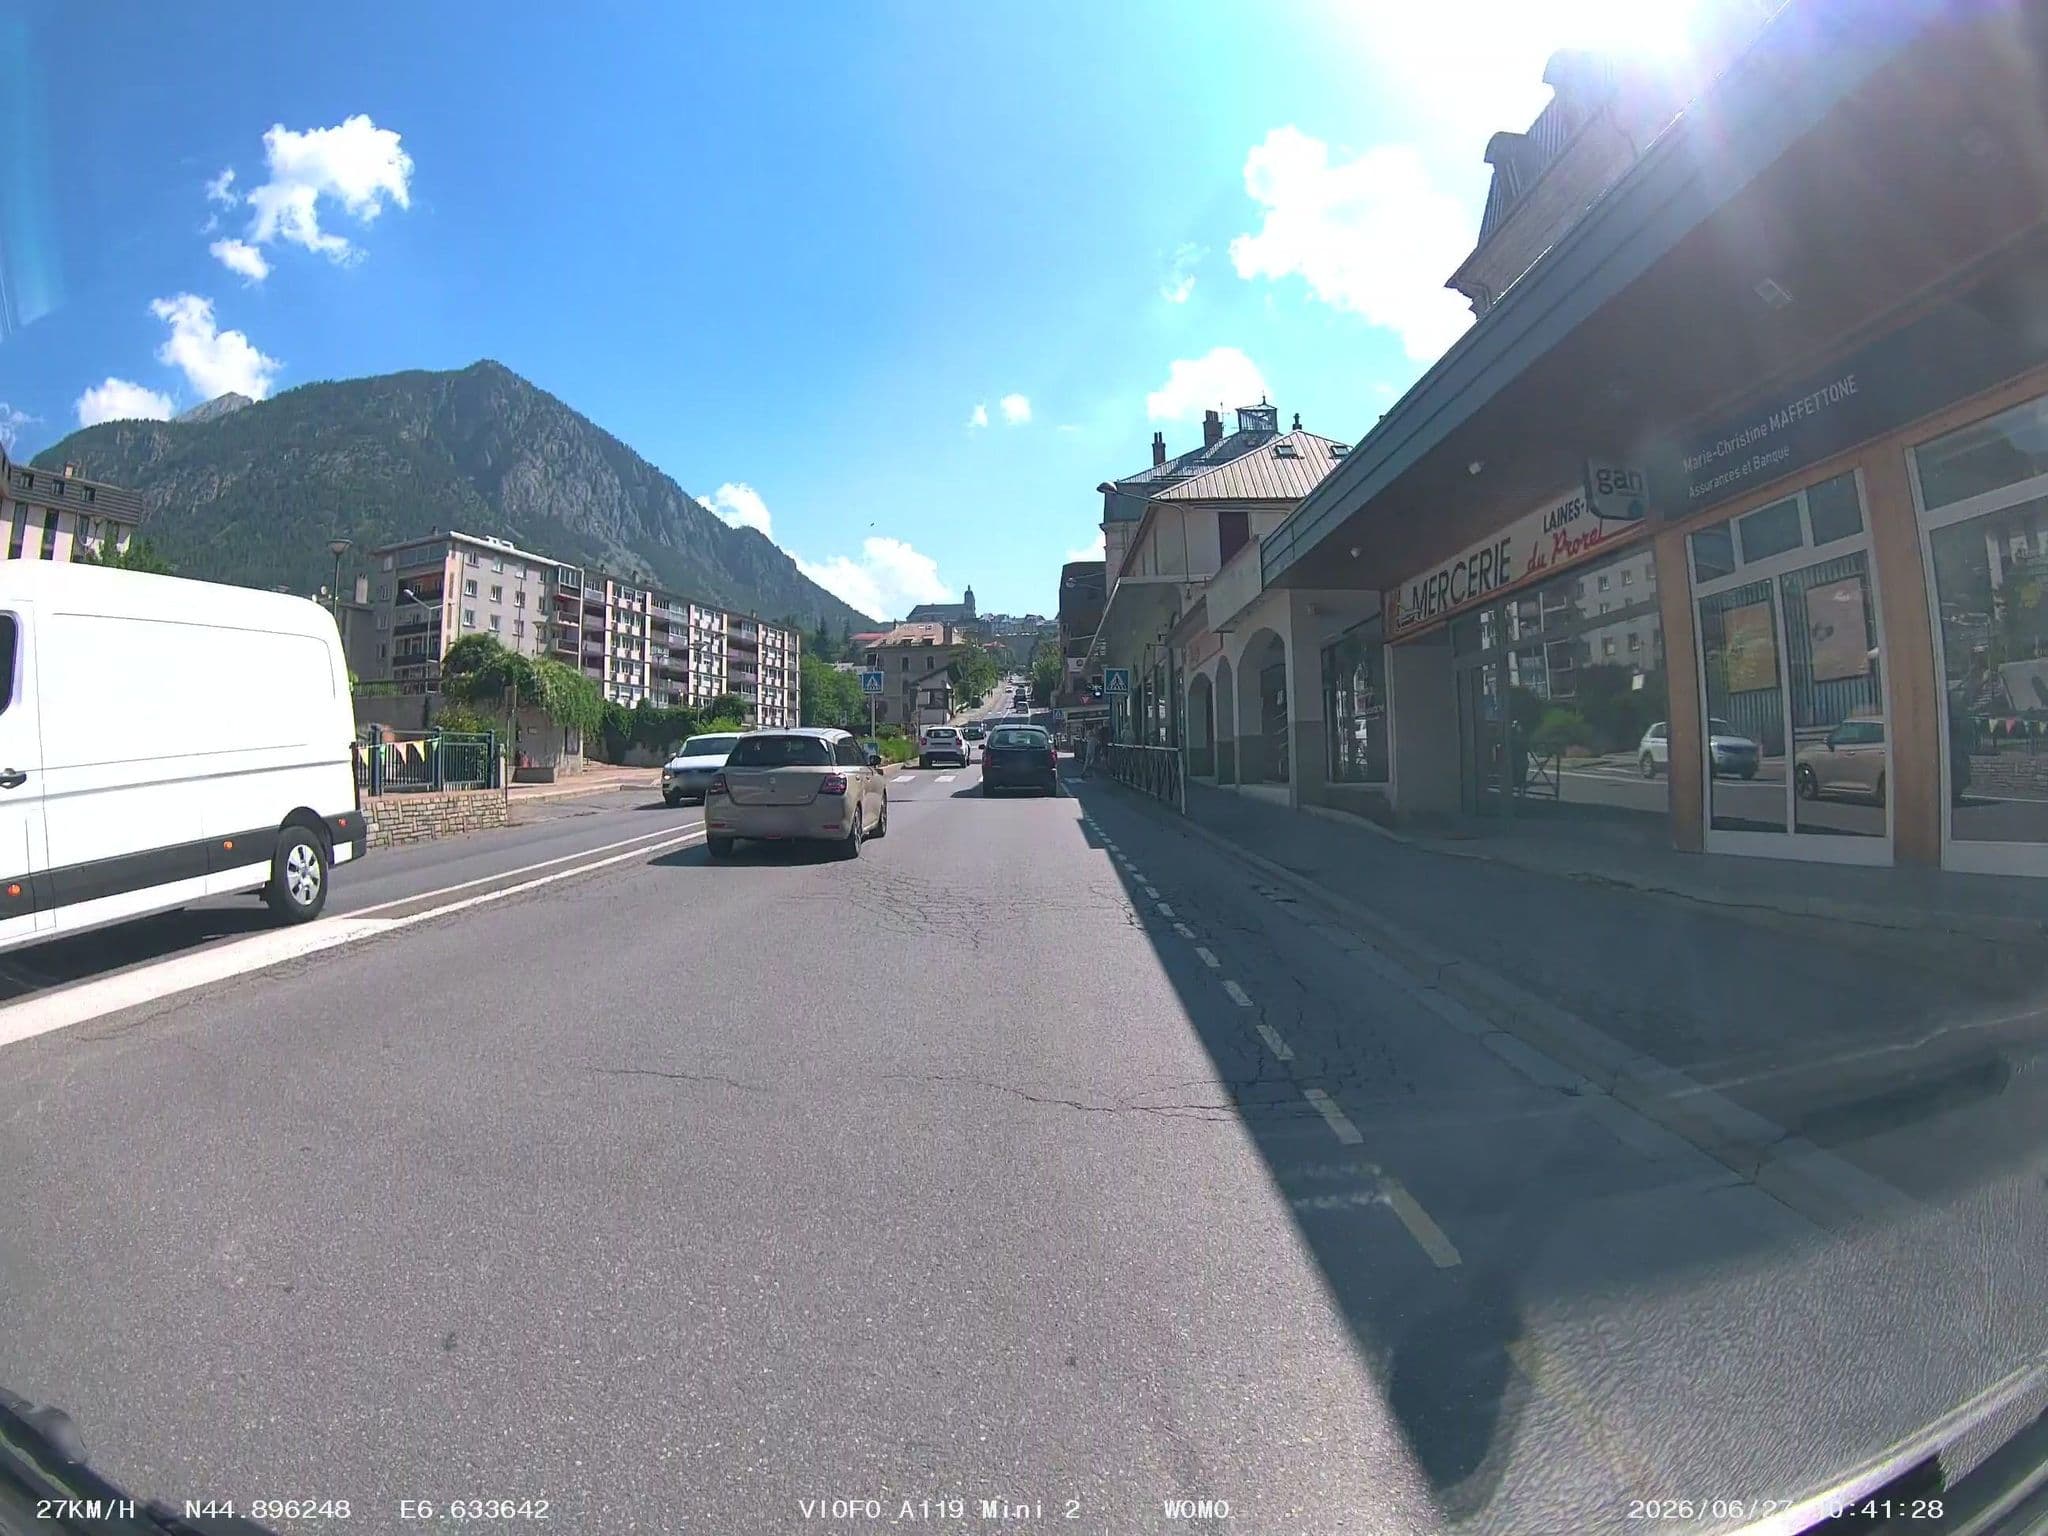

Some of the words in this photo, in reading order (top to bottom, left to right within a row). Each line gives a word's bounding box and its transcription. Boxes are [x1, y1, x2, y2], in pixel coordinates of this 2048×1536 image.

[1682, 423, 1768, 473] Marie-Christine
[1768, 374, 1858, 432] MAFFETTONE
[1596, 468, 1643, 495] gan
[1688, 467, 1741, 498] Assurances
[1742, 458, 1752, 475] et
[1752, 445, 1790, 470] Banque
[1411, 536, 1512, 620] MERCERIE
[1527, 541, 1548, 572] du
